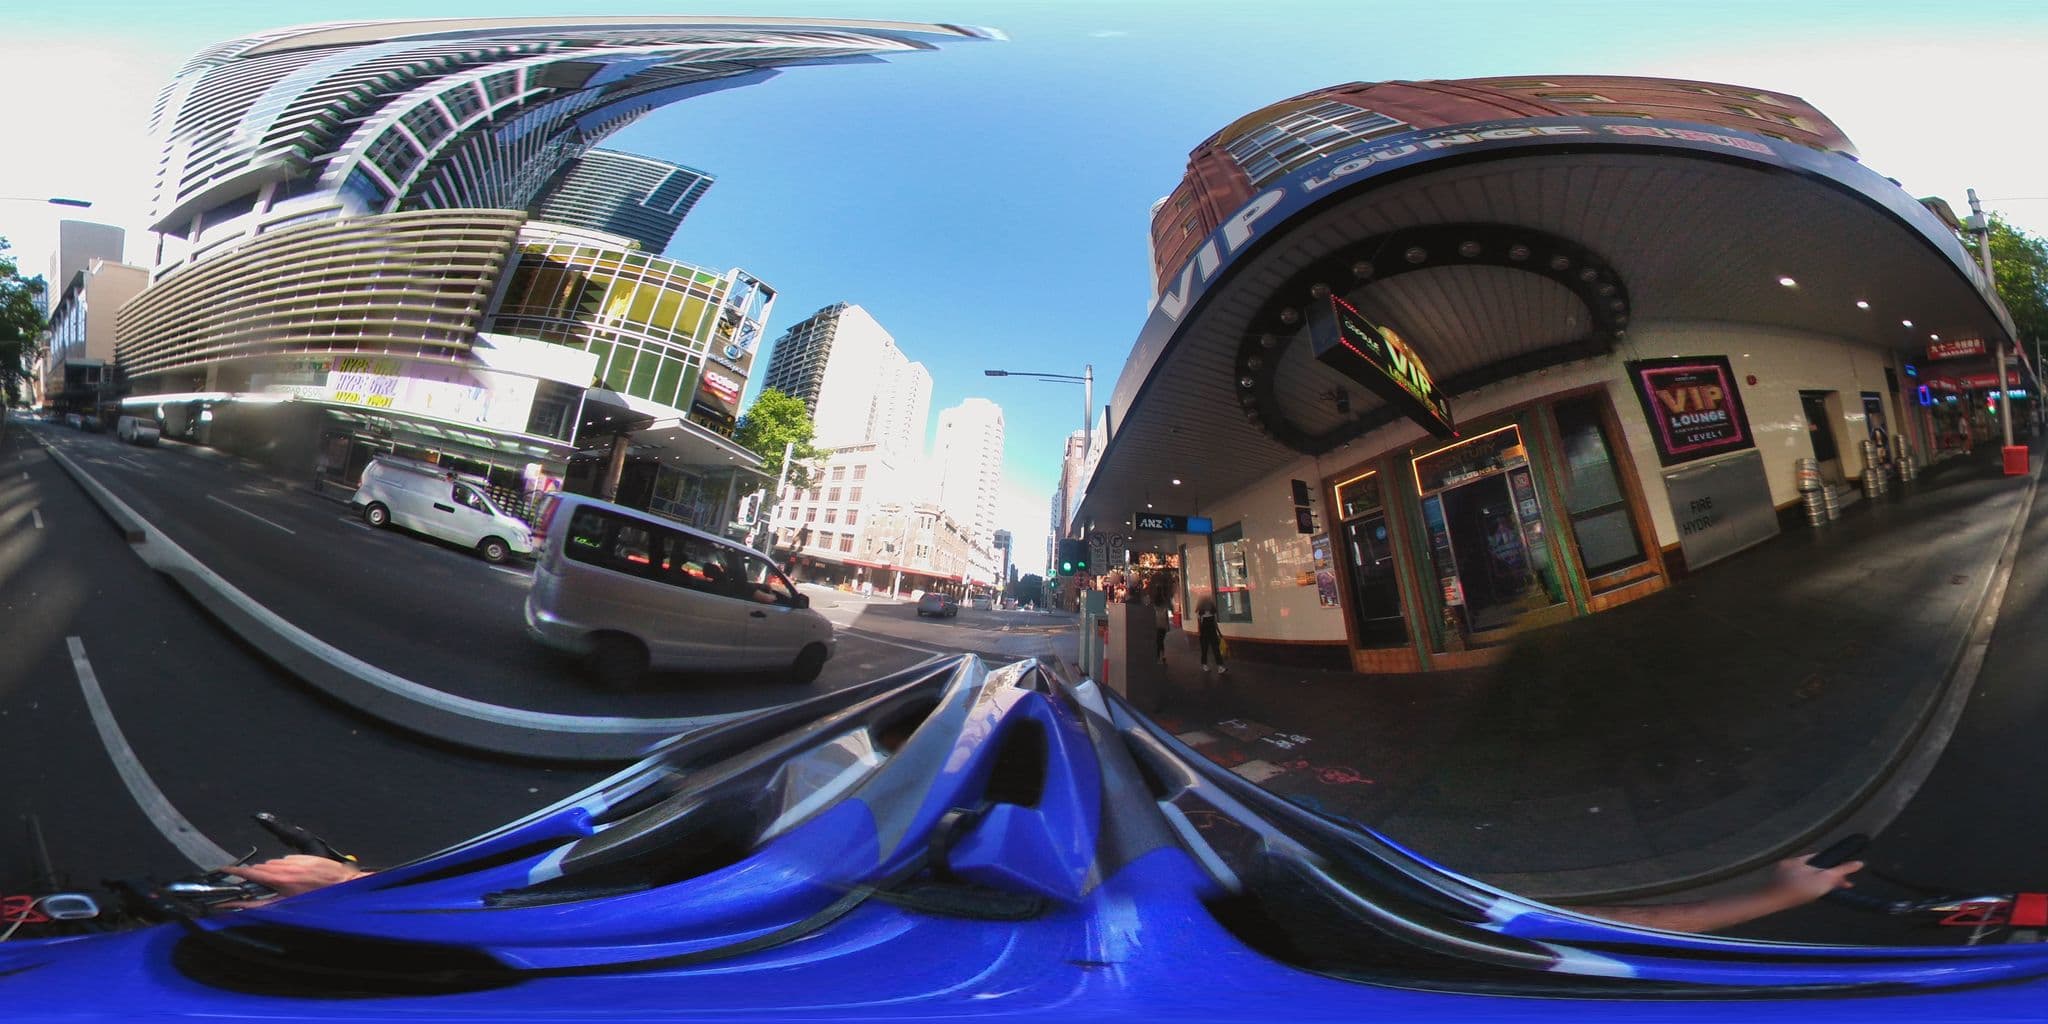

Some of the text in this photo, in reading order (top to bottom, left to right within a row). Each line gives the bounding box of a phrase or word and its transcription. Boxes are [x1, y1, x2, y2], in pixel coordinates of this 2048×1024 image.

[1333, 124, 1484, 164] CENTURY
[1160, 126, 1594, 322] VIP LOUNGE
[1383, 338, 1432, 394] VIP
[1655, 384, 1724, 414] VIP
[1671, 410, 1727, 428] LOUNGE
[1686, 431, 1717, 443] LEVEL
[1689, 496, 1713, 514] FIRE
[1139, 517, 1163, 529] ANZ
